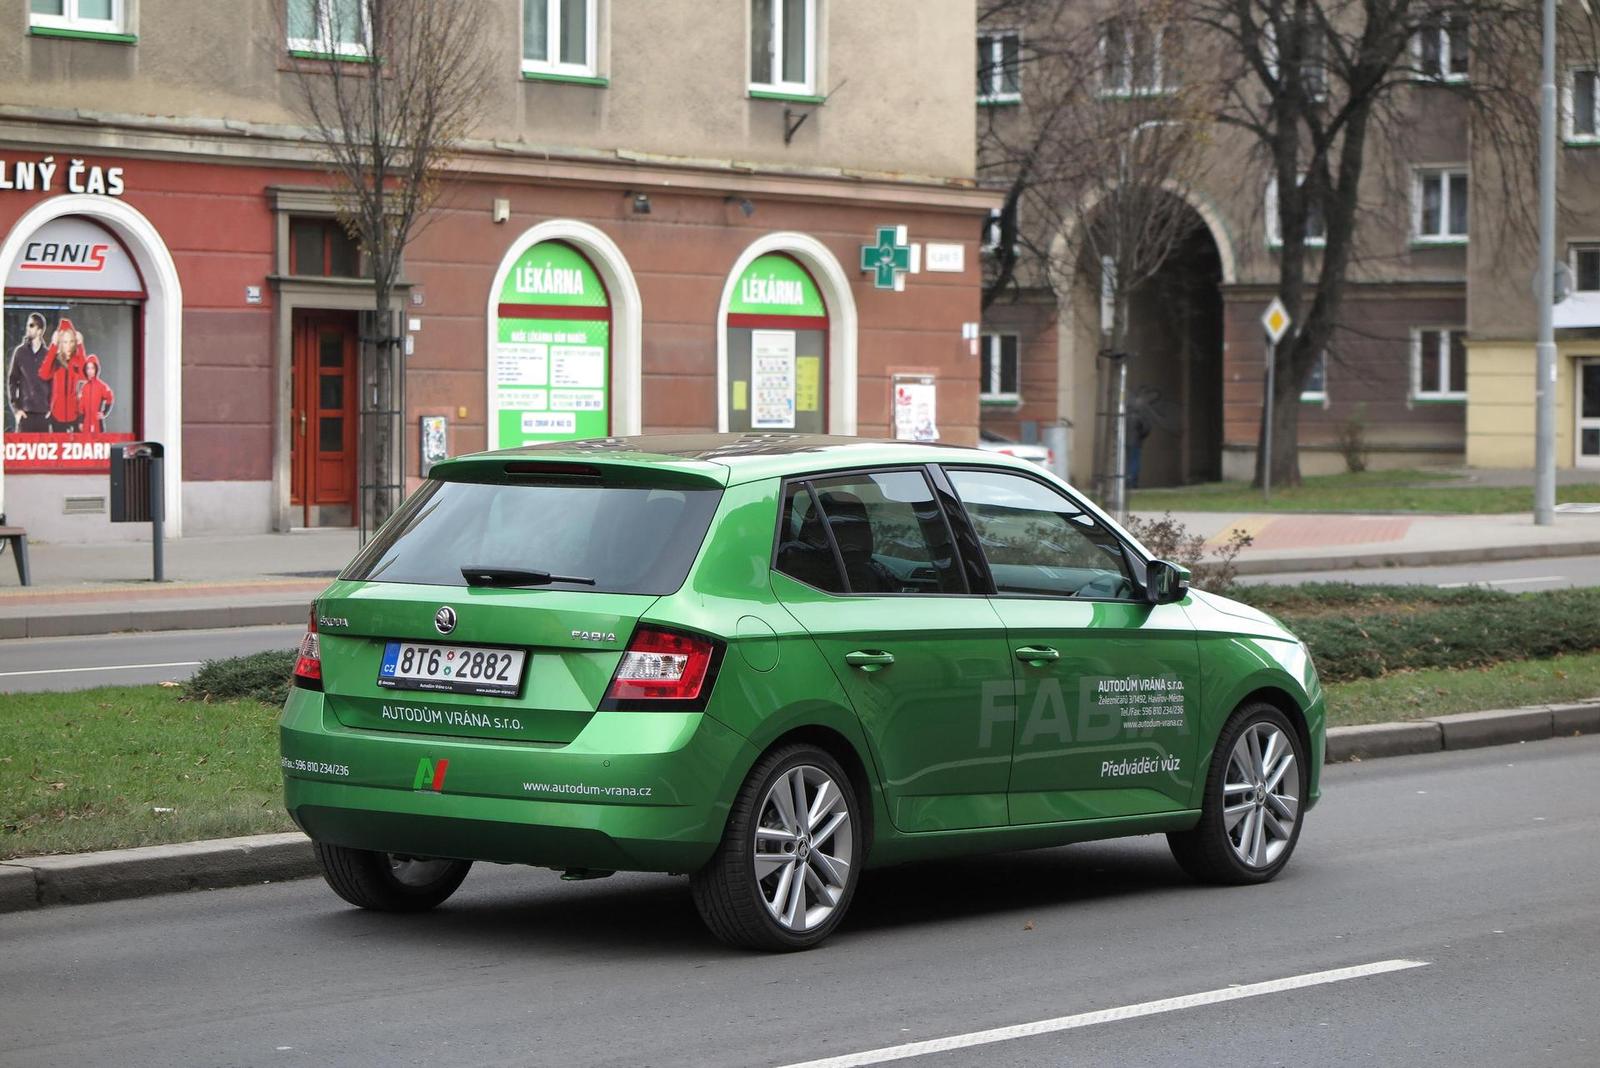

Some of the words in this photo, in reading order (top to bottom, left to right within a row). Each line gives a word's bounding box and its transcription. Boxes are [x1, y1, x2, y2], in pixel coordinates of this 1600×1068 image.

[69, 159, 124, 195] ČAS
[21, 243, 108, 271] CANIS
[516, 261, 584, 294] LÉKÁRNA
[742, 273, 804, 305] LÉKÁRNA
[3, 442, 58, 460] OZVOZ
[571, 630, 617, 642] FABIA
[383, 664, 395, 673] CZ
[400, 647, 441, 676] 8T6
[455, 650, 512, 682] 2882
[1098, 677, 1138, 693] AUTODŮM
[1139, 676, 1166, 691] VRÁNA
[1167, 681, 1184, 690] s.r.o.
[382, 705, 443, 724] AUTODŮM
[445, 711, 491, 728] VRÁNA
[494, 717, 524, 730] s.r.o.
[1123, 719, 1183, 729] www.autodum-vrana.cz
[295, 760, 306, 770] 596
[307, 761, 318, 772] 810
[320, 763, 349, 776] 234/236
[1101, 756, 1159, 778] Předváděcí
[1161, 753, 1181, 771] vůz
[523, 782, 652, 796] www.autodum-vrana.cz
